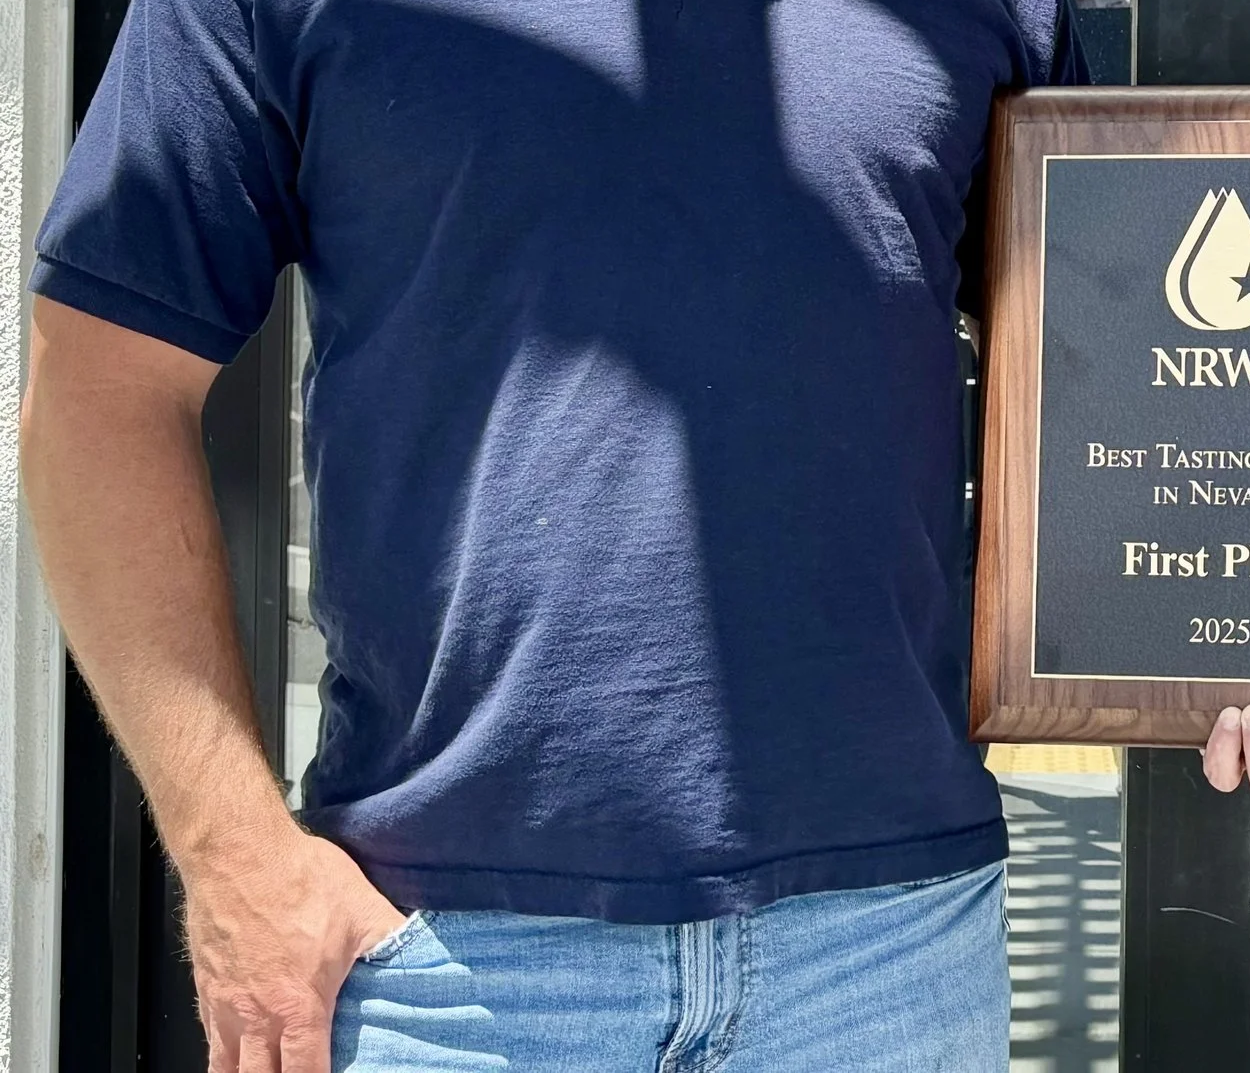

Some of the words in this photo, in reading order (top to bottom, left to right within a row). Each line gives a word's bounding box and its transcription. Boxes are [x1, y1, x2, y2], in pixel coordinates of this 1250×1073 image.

[1087, 443, 1147, 468] BEST
[1153, 486, 1179, 505] IN
[1122, 542, 1210, 577] First
[1189, 618, 1250, 644] 2025
